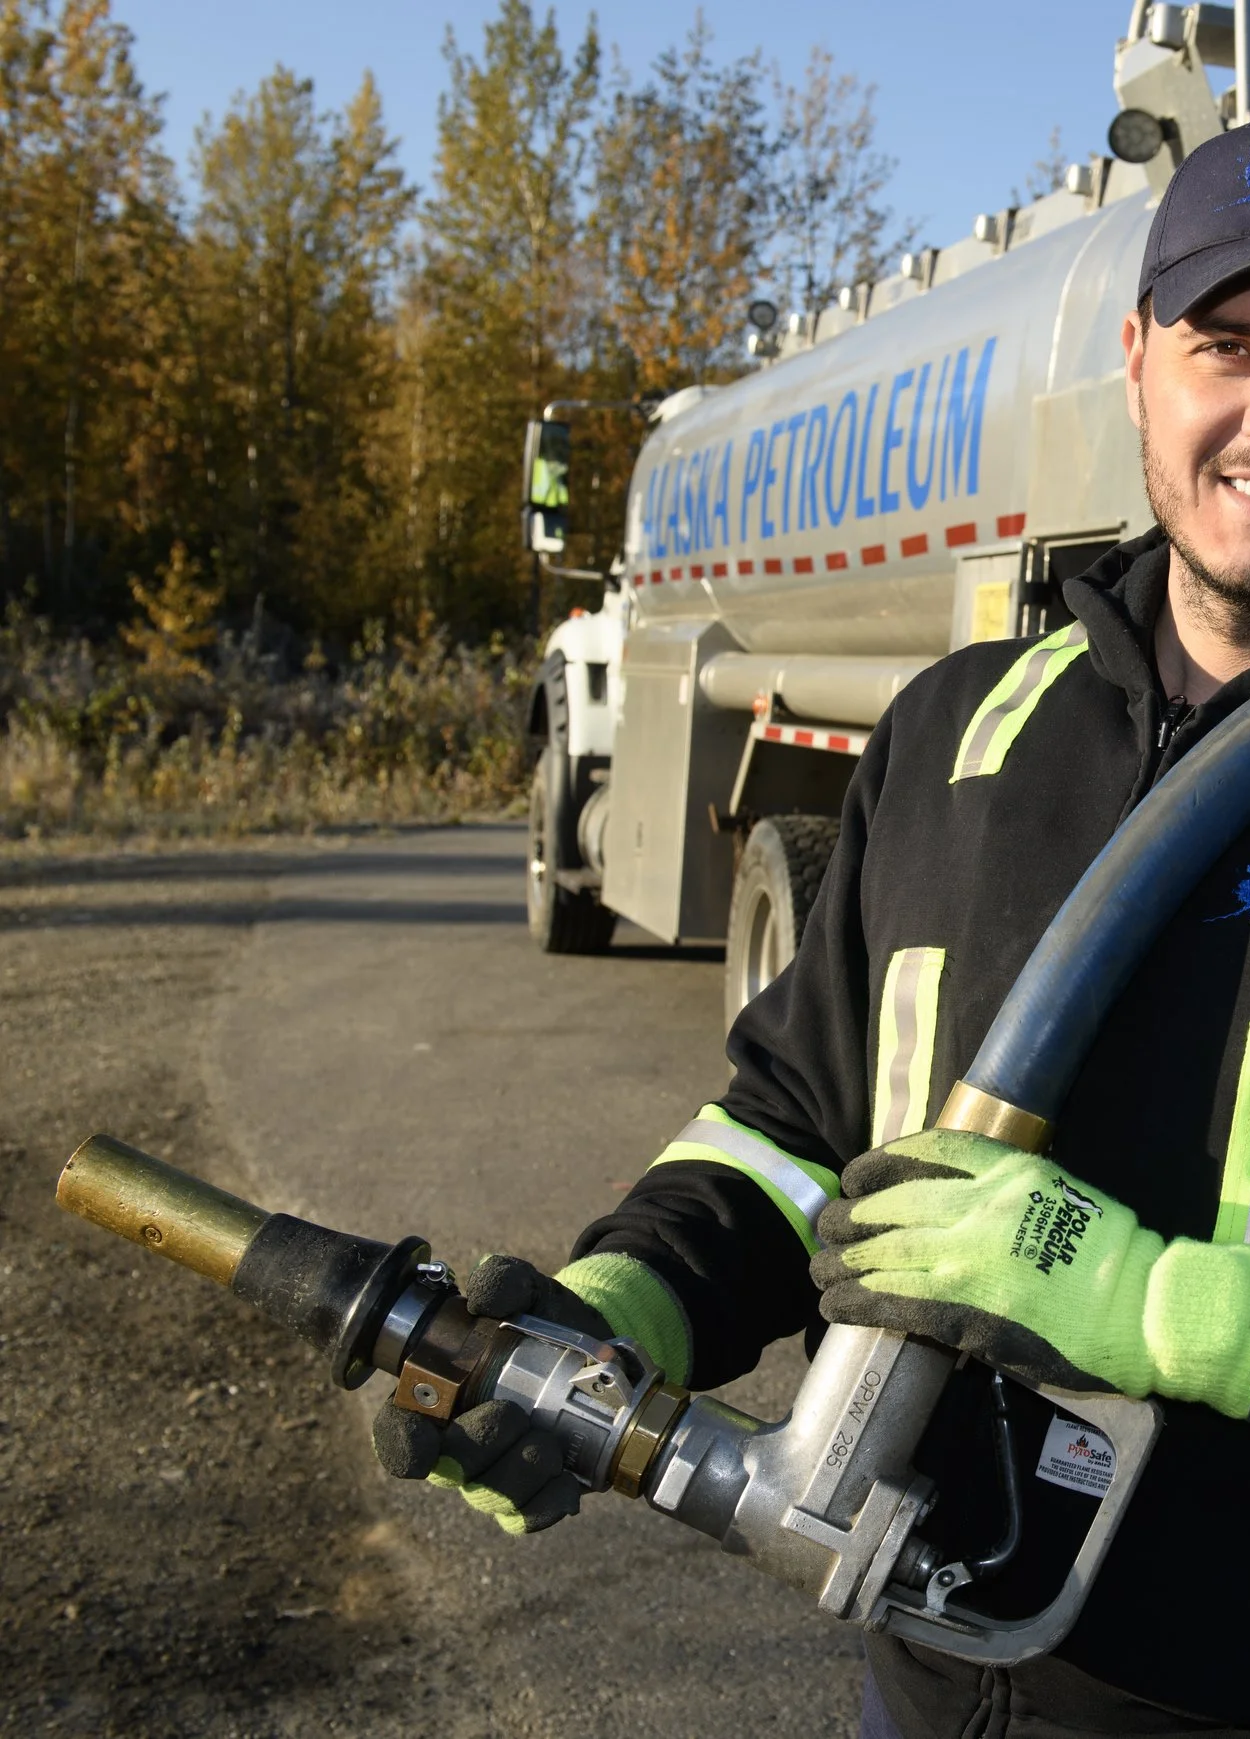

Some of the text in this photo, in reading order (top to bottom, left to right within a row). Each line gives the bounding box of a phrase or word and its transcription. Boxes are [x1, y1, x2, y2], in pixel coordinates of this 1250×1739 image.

[643, 335, 998, 559] ALASKA PETROLEUM
[1010, 1205, 1036, 1258] MAJESTIC
[1030, 1197, 1057, 1244] 3396HY
[1036, 1198, 1076, 1275] PENGUIN
[1057, 1208, 1091, 1265] POLAR
[826, 1370, 882, 1469] OPW 295
[1067, 1443, 1112, 1466] PyroSafe
